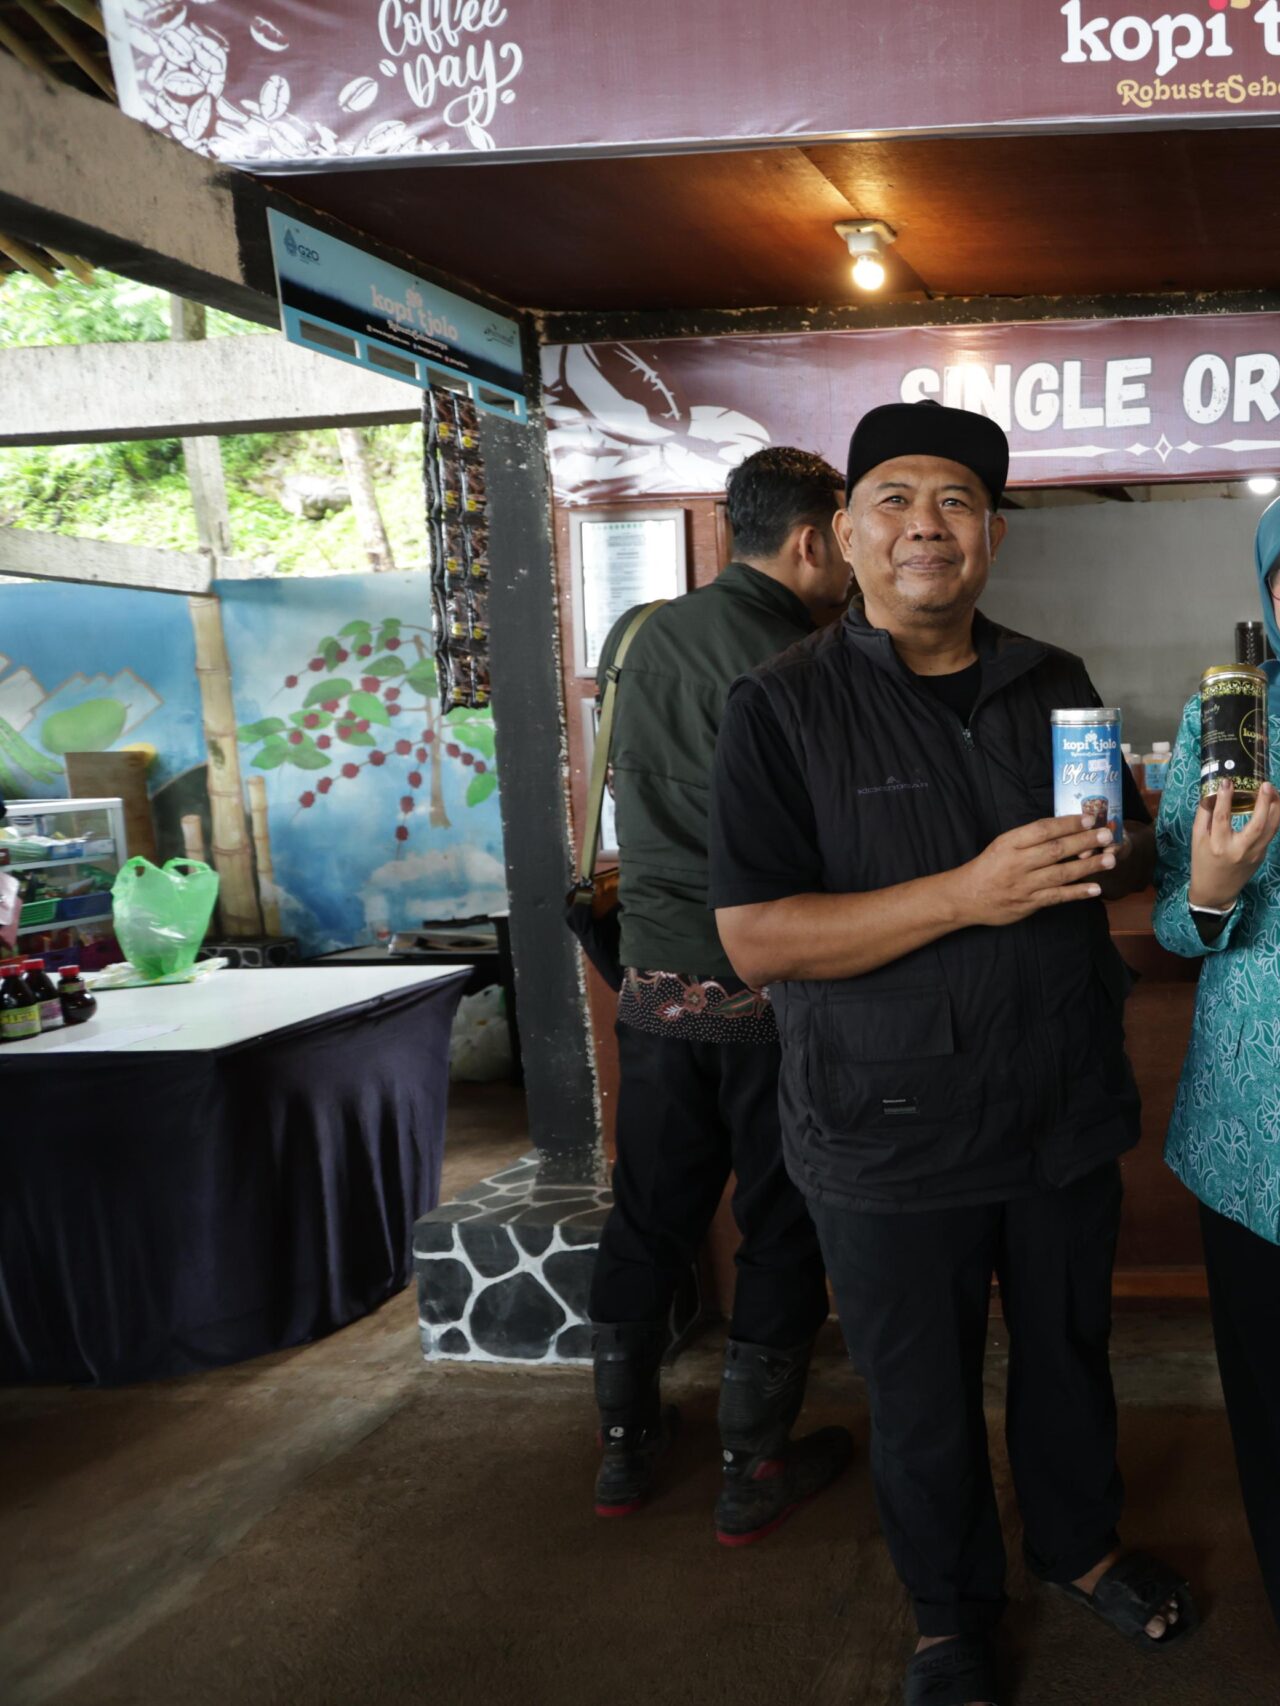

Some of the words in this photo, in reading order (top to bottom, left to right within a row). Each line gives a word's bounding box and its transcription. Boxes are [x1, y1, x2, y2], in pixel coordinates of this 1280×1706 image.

[378, 0, 508, 56] Coffee
[1060, 0, 1233, 76] kopi
[403, 40, 523, 127] Day
[370, 285, 414, 323] kopi
[417, 305, 458, 341] tjolo
[899, 356, 1153, 432] SINGLE
[1062, 738, 1090, 752] kopi
[1092, 738, 1117, 752] tjolo
[1062, 762, 1097, 785] Blue
